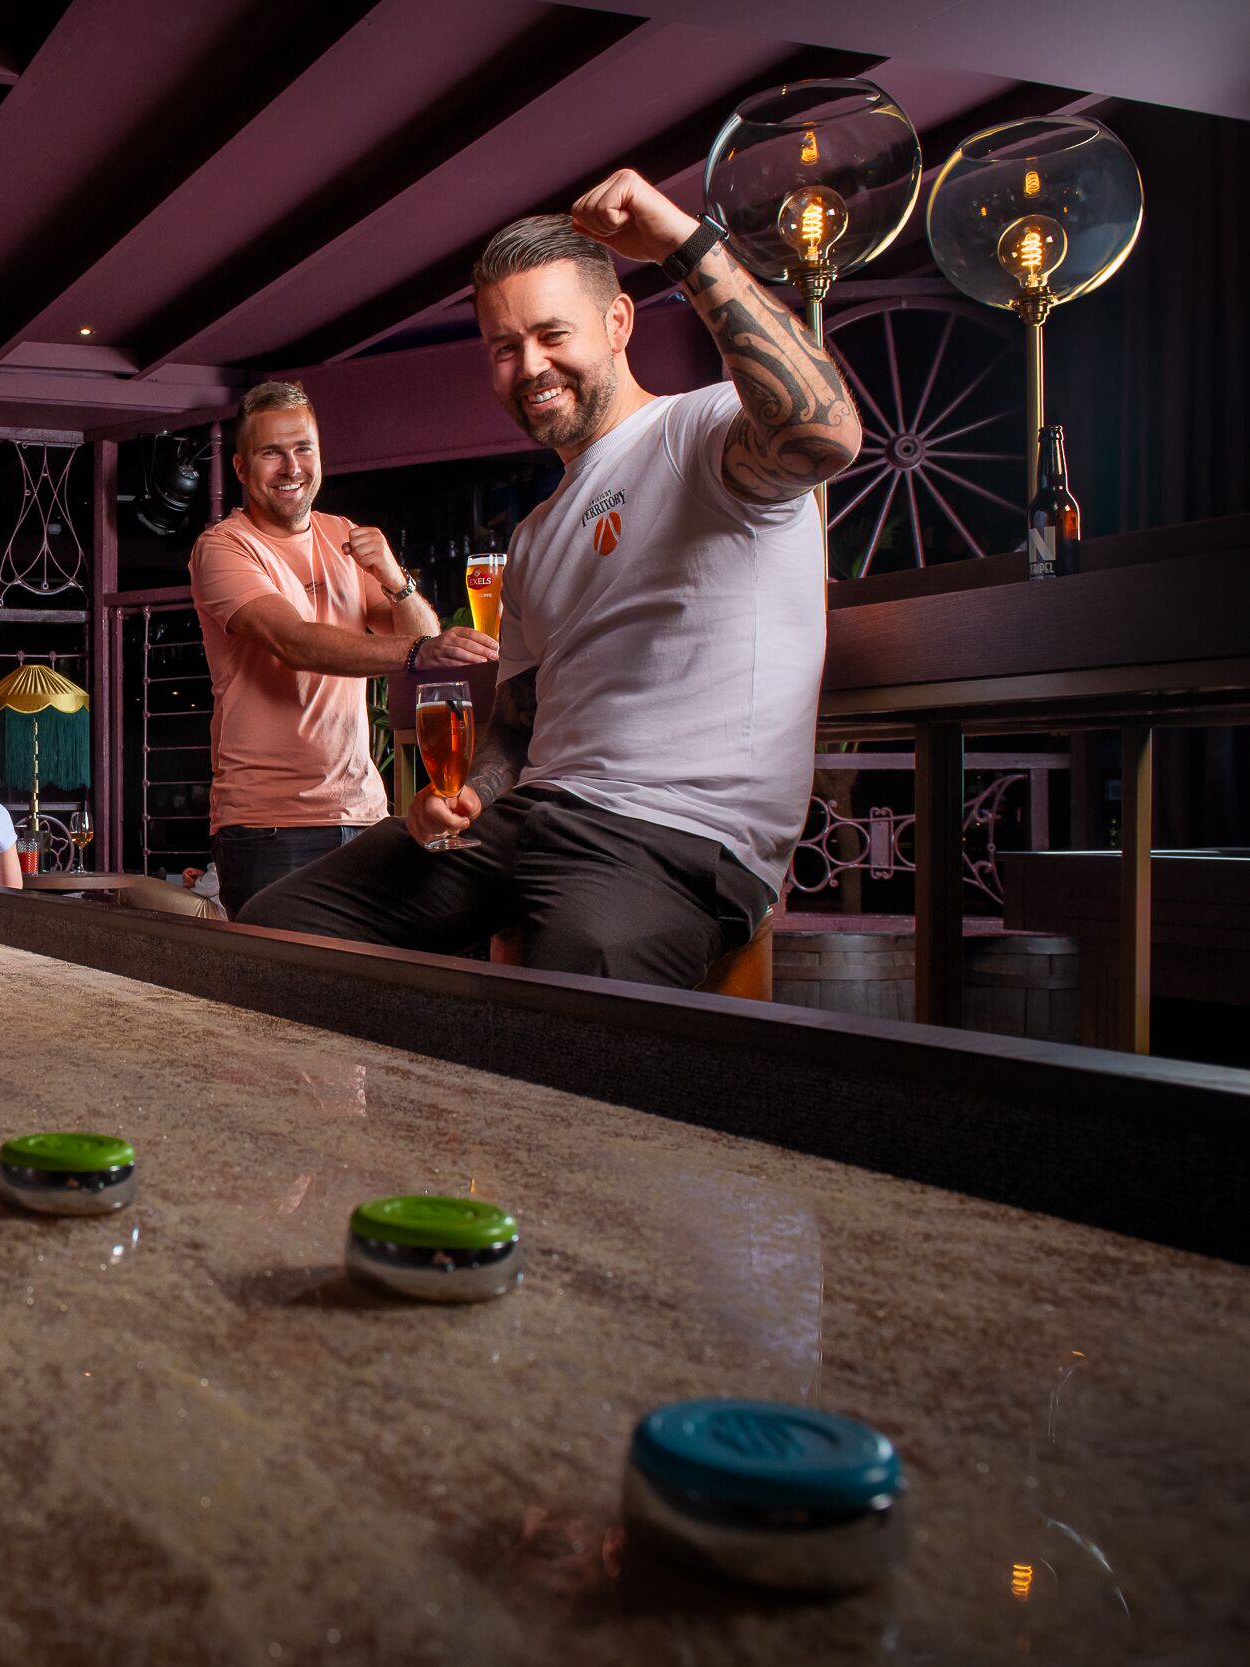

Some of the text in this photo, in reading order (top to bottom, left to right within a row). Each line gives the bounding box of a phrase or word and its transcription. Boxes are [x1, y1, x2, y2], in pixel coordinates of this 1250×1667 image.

[581, 488, 626, 528] TERRITORY
[1028, 525, 1057, 563] N
[1030, 562, 1055, 576] TRIPEL
